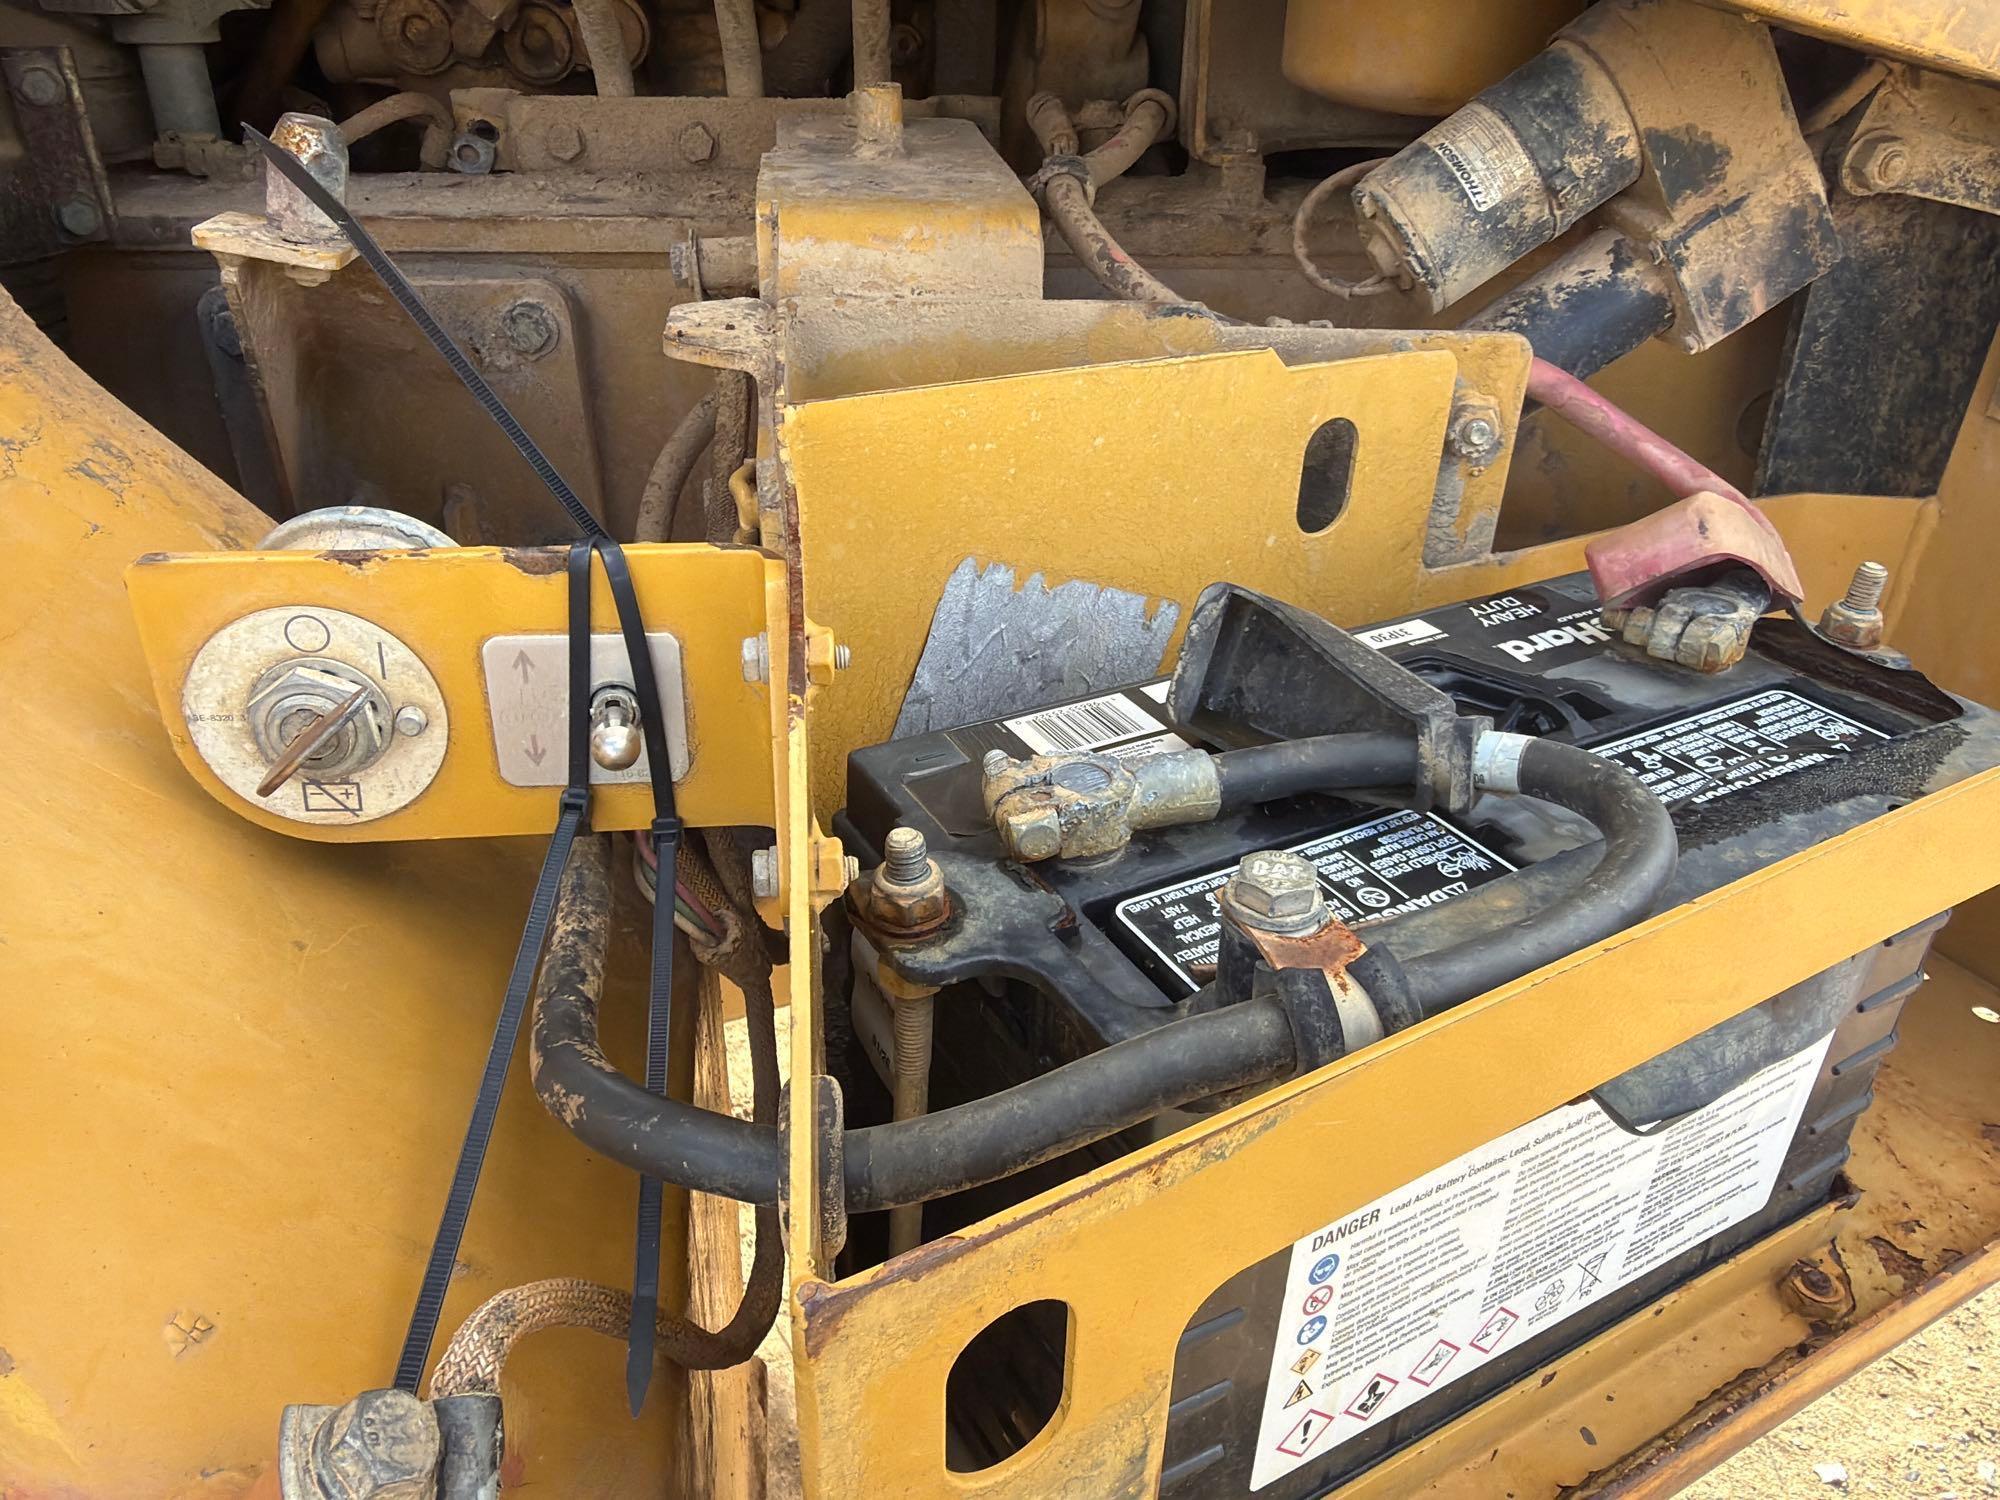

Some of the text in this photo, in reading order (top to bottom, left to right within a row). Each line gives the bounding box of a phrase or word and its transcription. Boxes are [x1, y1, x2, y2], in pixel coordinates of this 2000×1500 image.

[1436, 142, 1483, 197] THOMSON
[1468, 596, 1522, 617] DUTY
[1478, 604, 1542, 627] HEAVY
[1557, 610, 1595, 623] AHEAD
[1371, 628, 1413, 642] 31P30
[1304, 839, 1342, 855] CHILDREN
[1398, 833, 1428, 846] CAUSE
[1370, 842, 1402, 857] INJURY
[1370, 835, 1457, 869] EXPLOSIVE GASES
[1310, 852, 1344, 866] SMOKIN
[1316, 859, 1353, 874] FLAMES
[1380, 851, 1448, 877] SHIELD EYES
[1328, 865, 1363, 881] SPARKS
[1184, 882, 1209, 894] CAPS
[1345, 877, 1364, 887] NO
[1161, 889, 1188, 902] TIGHT
[1123, 900, 1153, 912] LEVEL
[1160, 903, 1188, 918] FAST
[1173, 914, 1200, 929] HELP
[1176, 922, 1220, 942] MEDICAL
[1174, 939, 1219, 962] EDIATELY
[1389, 1198, 1411, 1215] Lead
[1412, 1187, 1433, 1204] Acid
[1435, 1173, 1466, 1193] Battery
[1468, 1154, 1507, 1177] Contains:
[1509, 1142, 1530, 1158] Lead,
[1532, 1127, 1563, 1146] Sulfuric
[1565, 1116, 1583, 1132] Acid
[1312, 1209, 1379, 1251] DANGER
